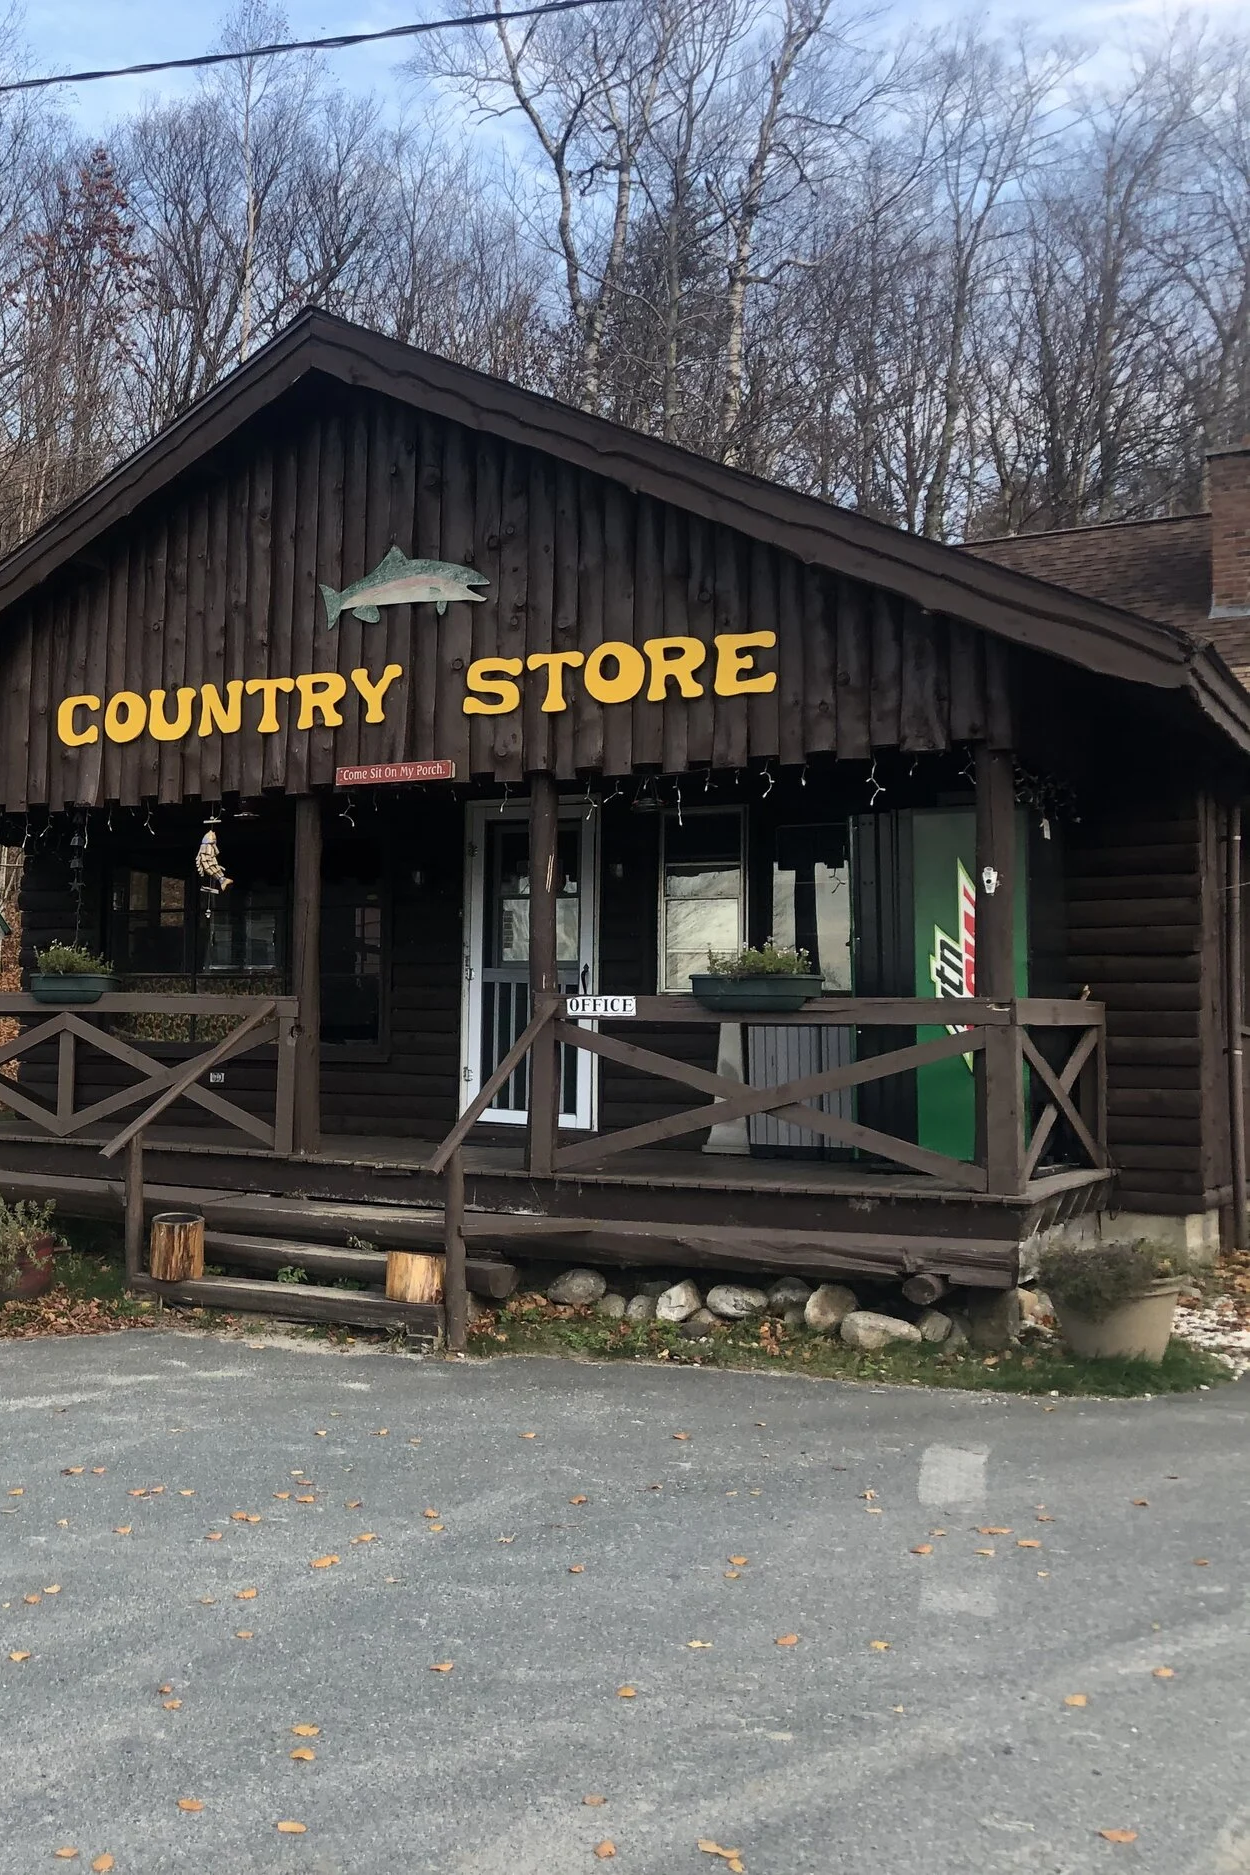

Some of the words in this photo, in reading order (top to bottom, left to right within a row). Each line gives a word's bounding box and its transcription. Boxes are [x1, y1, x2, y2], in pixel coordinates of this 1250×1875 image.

[57, 663, 403, 747] COUNTRY
[463, 630, 777, 715] STORE
[370, 767, 382, 779] Sit
[384, 766, 397, 777] On
[400, 765, 414, 779] My
[569, 998, 635, 1012] OFFICE
